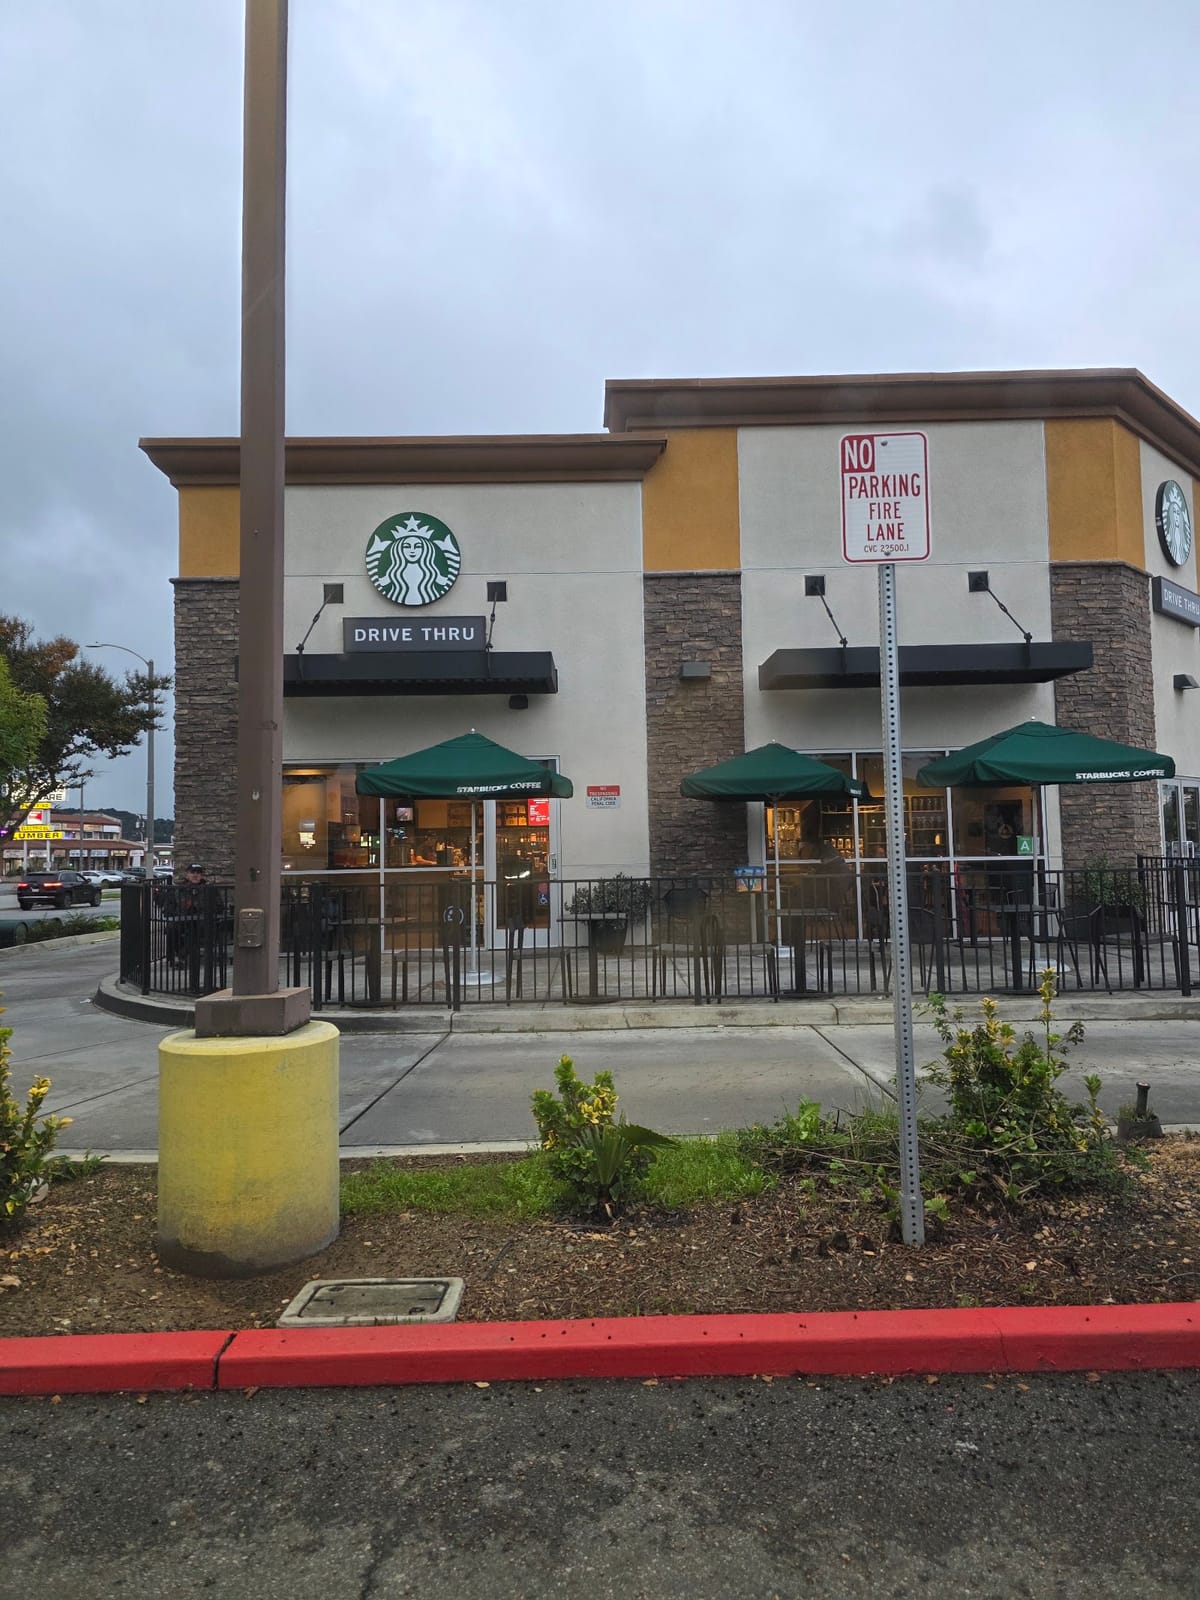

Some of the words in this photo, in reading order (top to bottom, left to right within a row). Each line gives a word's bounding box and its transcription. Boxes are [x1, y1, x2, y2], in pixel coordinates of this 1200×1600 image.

[845, 439, 873, 469] NO
[849, 473, 921, 499] PARKING
[869, 501, 902, 520] FIRE
[867, 522, 905, 541] LANE
[864, 544, 878, 553] CVC
[1164, 588, 1182, 608] DRIVE
[1184, 598, 1200, 615] THRU
[354, 628, 413, 642] DRIVE
[421, 627, 475, 641] THRU
[1075, 770, 1131, 780] STARBUCKS
[1132, 769, 1165, 778] COFFEE
[456, 784, 509, 793] STARBUCKS
[509, 781, 542, 790] COFFEE
[1020, 840, 1030, 851] A
